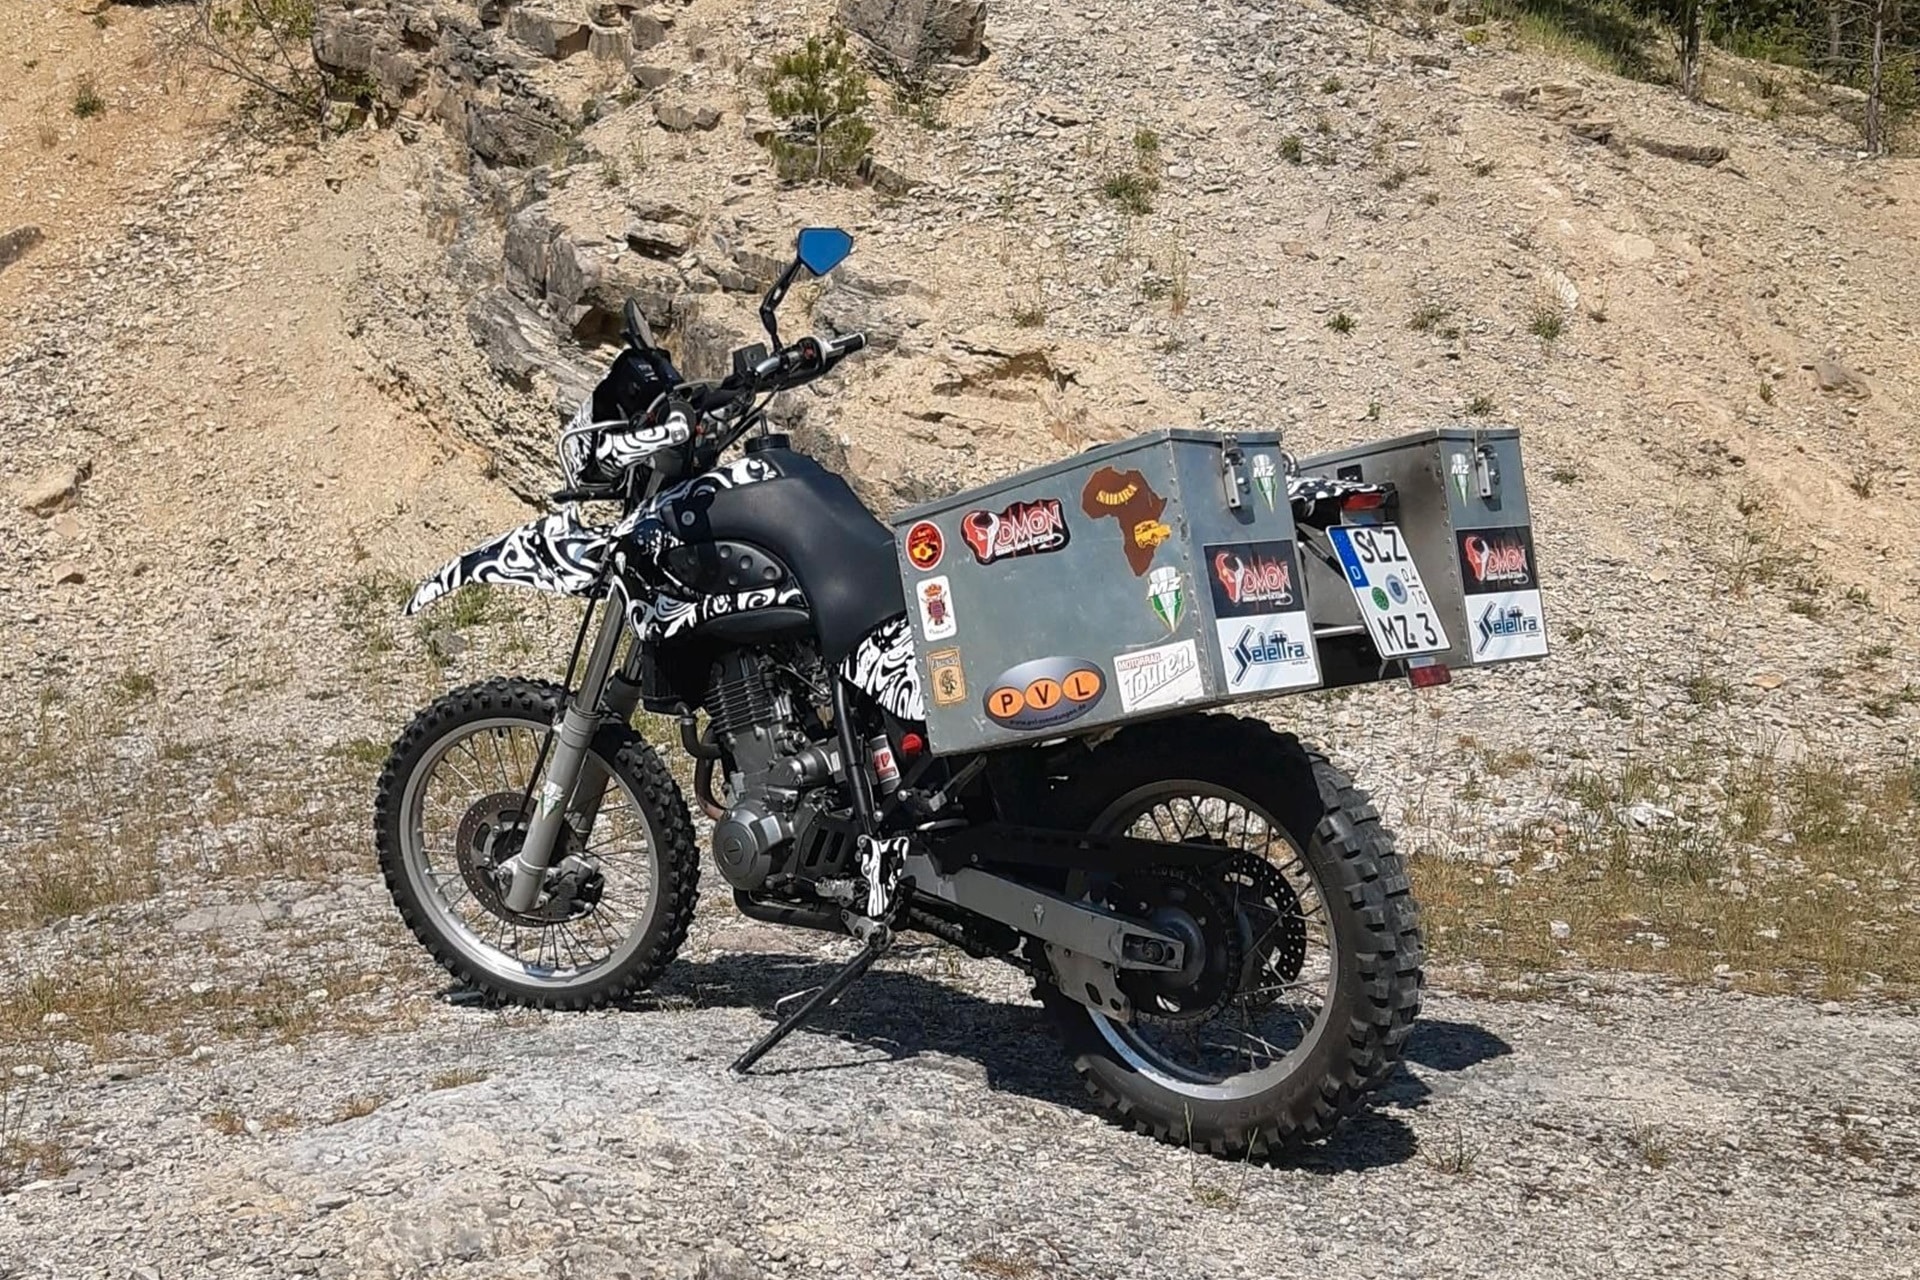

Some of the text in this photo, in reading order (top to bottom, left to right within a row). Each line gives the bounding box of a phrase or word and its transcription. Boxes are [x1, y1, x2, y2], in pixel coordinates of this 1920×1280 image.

[1252, 464, 1276, 478] MZ
[1096, 483, 1138, 505] SAHARA
[1353, 529, 1408, 564] SLZ
[1350, 565, 1362, 580] D
[1147, 576, 1182, 598] MZ
[1377, 612, 1439, 652] MZ 3
[1117, 652, 1162, 672] MOTORRAD
[1124, 646, 1192, 702] Touren
